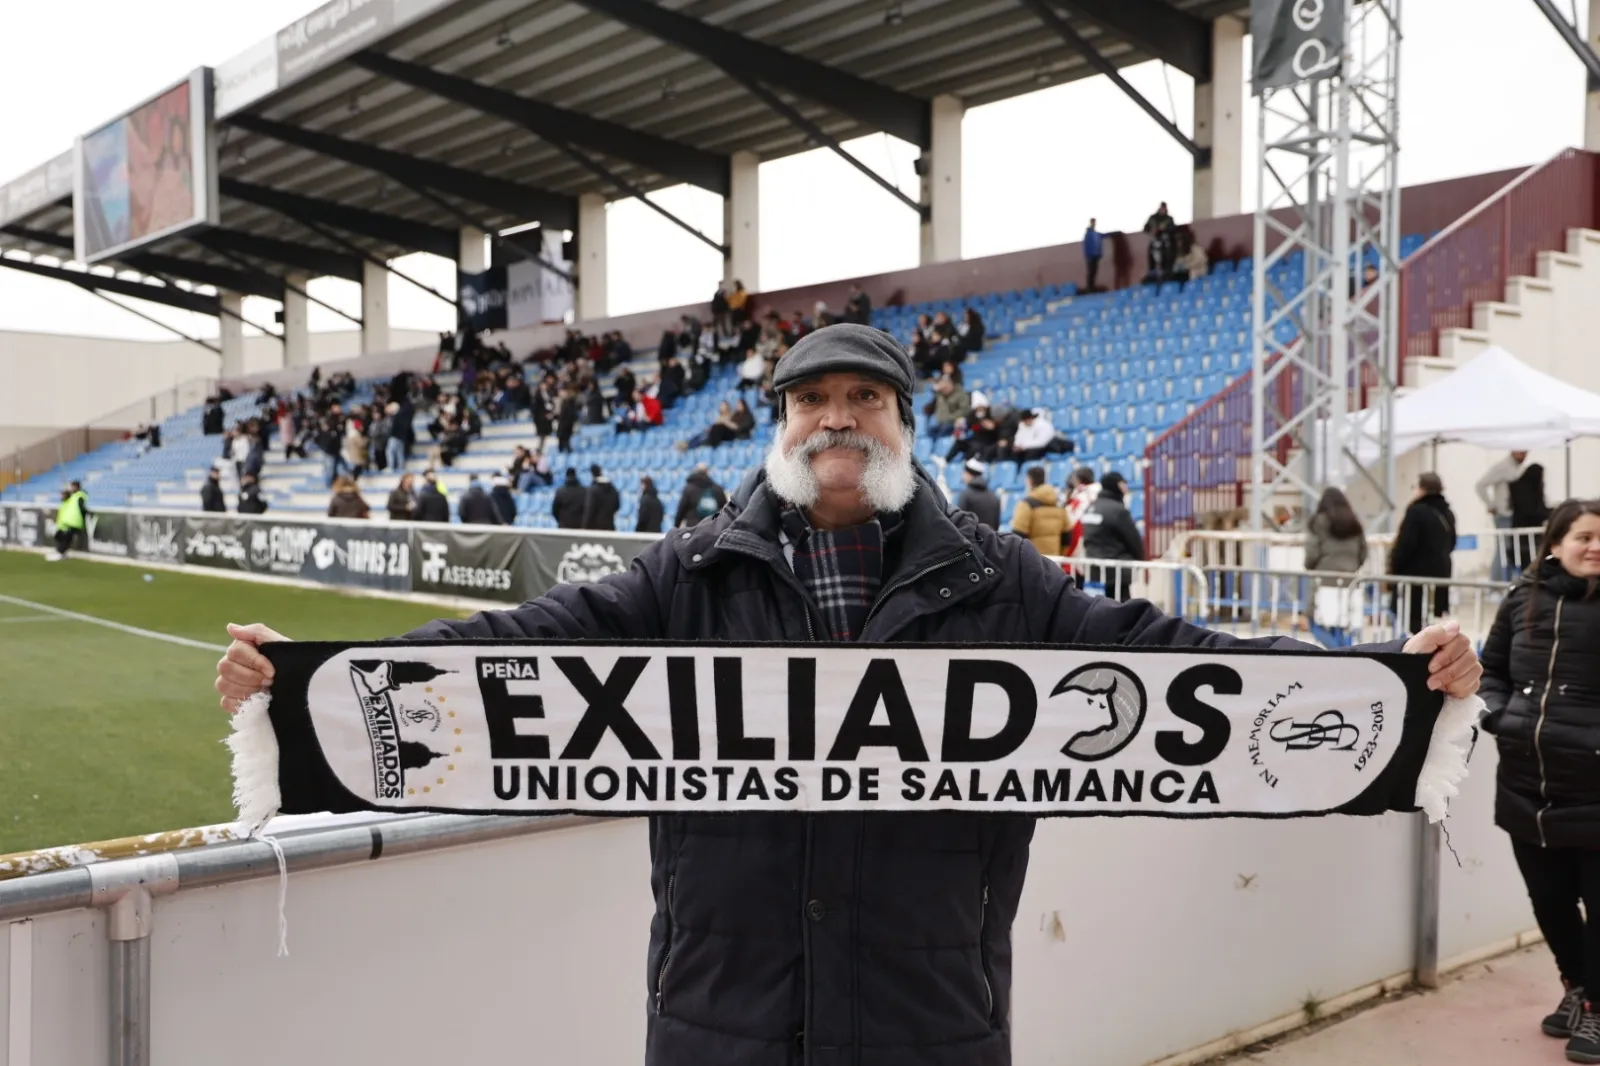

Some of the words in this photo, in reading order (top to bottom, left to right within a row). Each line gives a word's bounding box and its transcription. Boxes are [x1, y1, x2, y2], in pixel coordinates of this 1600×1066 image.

[442, 565, 511, 590] ASESORES
[481, 659, 537, 678] PEÑA
[362, 696, 379, 740] UNIONISTAS
[1248, 681, 1304, 766] MEMORIAM
[369, 695, 400, 798] EXILIADOS
[493, 765, 800, 802] UNIONISTAS
[822, 766, 880, 802] DE
[901, 767, 1221, 804] SALAMANCA
[1259, 768, 1279, 788] IN
